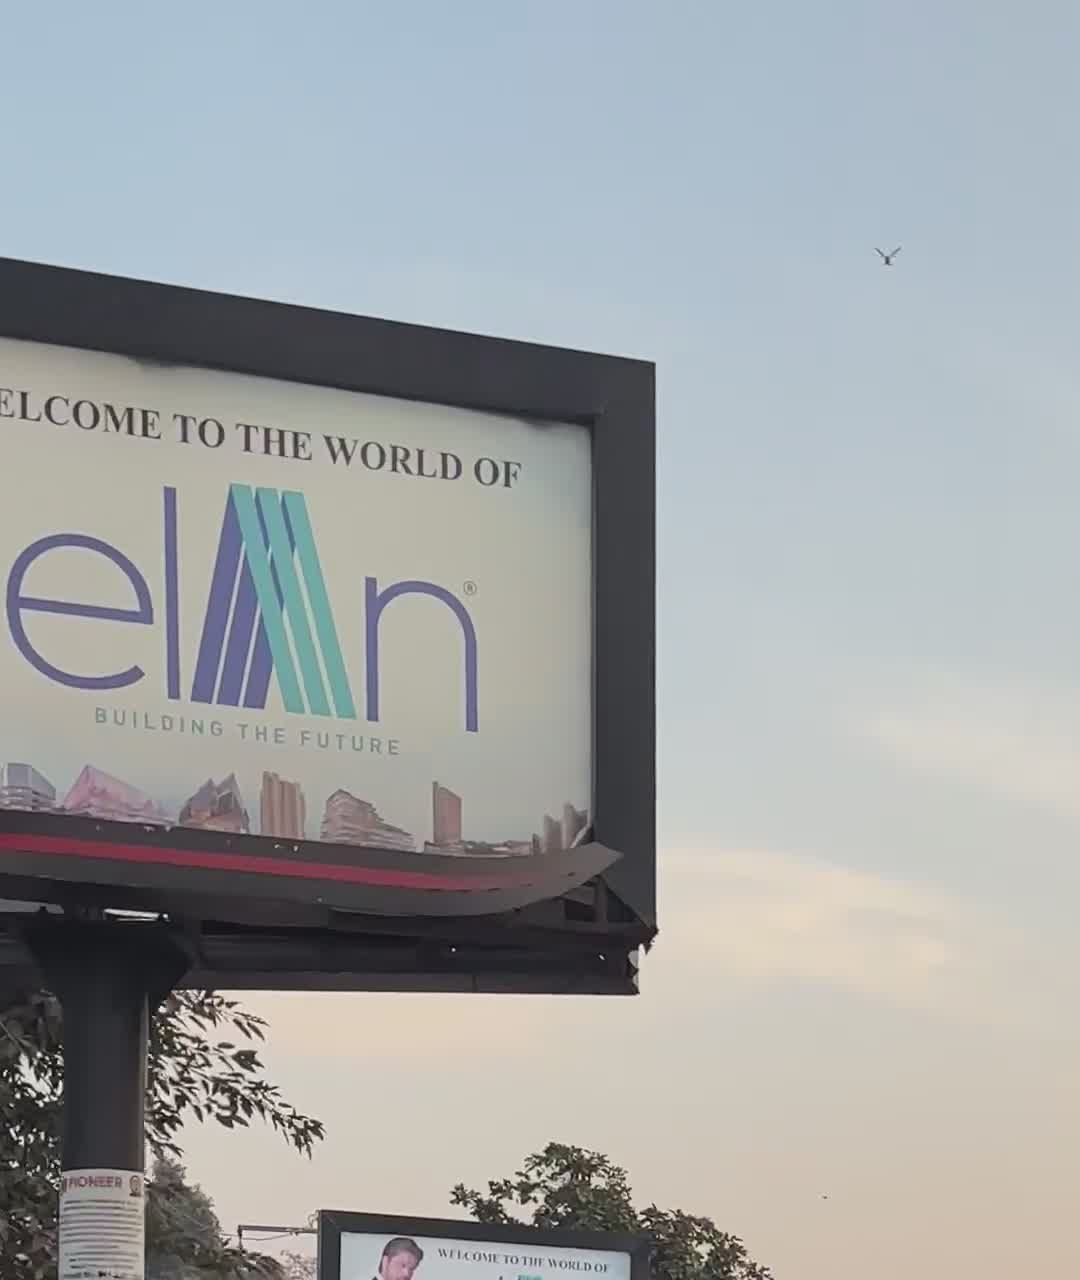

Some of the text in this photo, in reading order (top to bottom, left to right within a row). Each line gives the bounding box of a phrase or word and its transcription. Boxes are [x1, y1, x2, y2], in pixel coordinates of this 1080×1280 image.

[173, 413, 225, 449] TO
[235, 423, 313, 461] THE
[323, 434, 463, 481] WORLD
[473, 457, 522, 489] OF
[95, 706, 400, 756] BUILDING THE FUTURE
[438, 1248, 610, 1274] WELCOME TO THE WORLD OF
